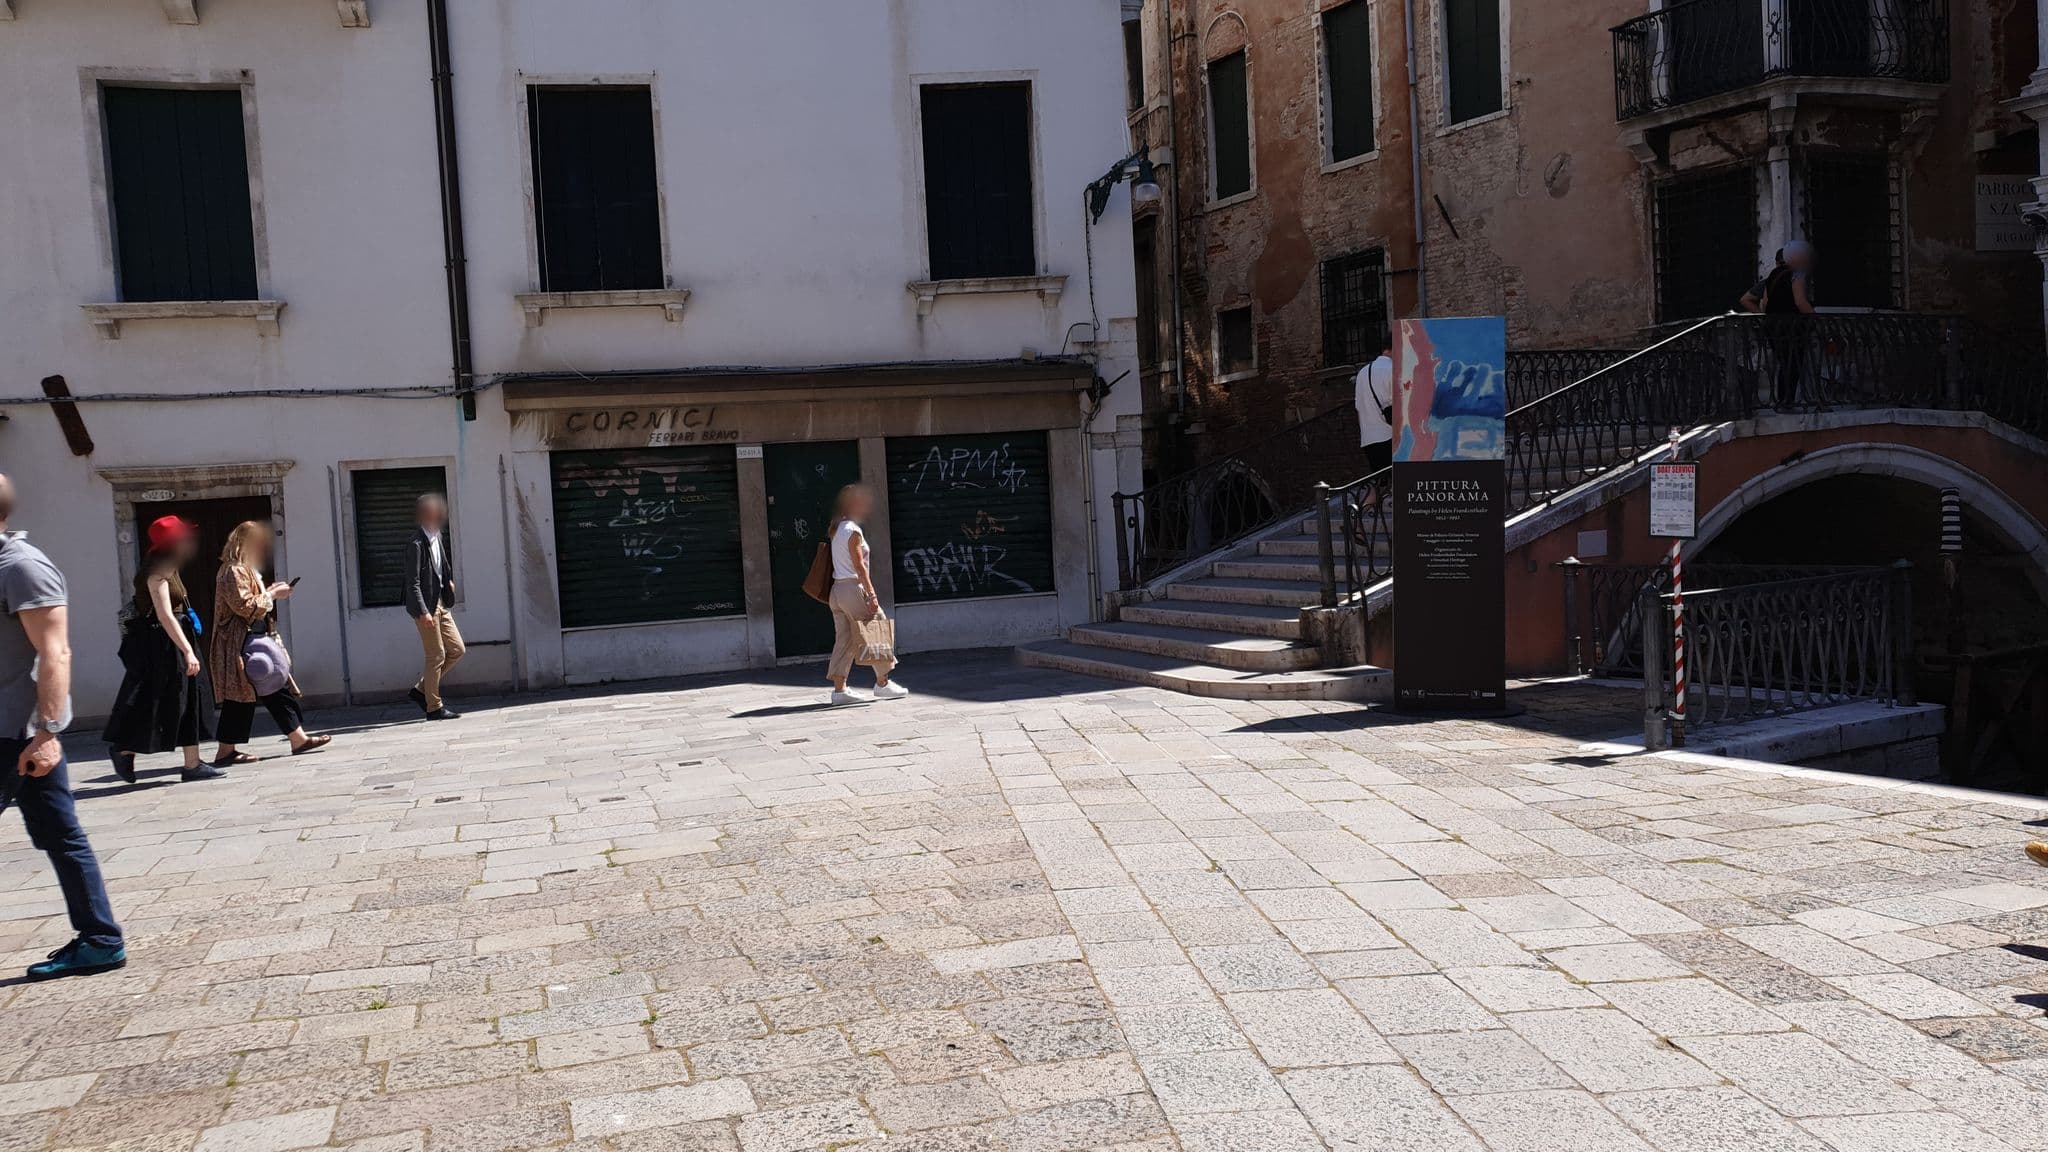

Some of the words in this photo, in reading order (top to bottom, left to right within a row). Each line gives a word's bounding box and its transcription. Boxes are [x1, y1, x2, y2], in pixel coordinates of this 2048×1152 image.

[566, 407, 715, 432] CORNICI
[702, 430, 739, 441] BRAVO
[1671, 465, 1695, 474] SERVICE
[1416, 480, 1480, 491] PITTURA
[1407, 492, 1489, 502] PANORAMA
